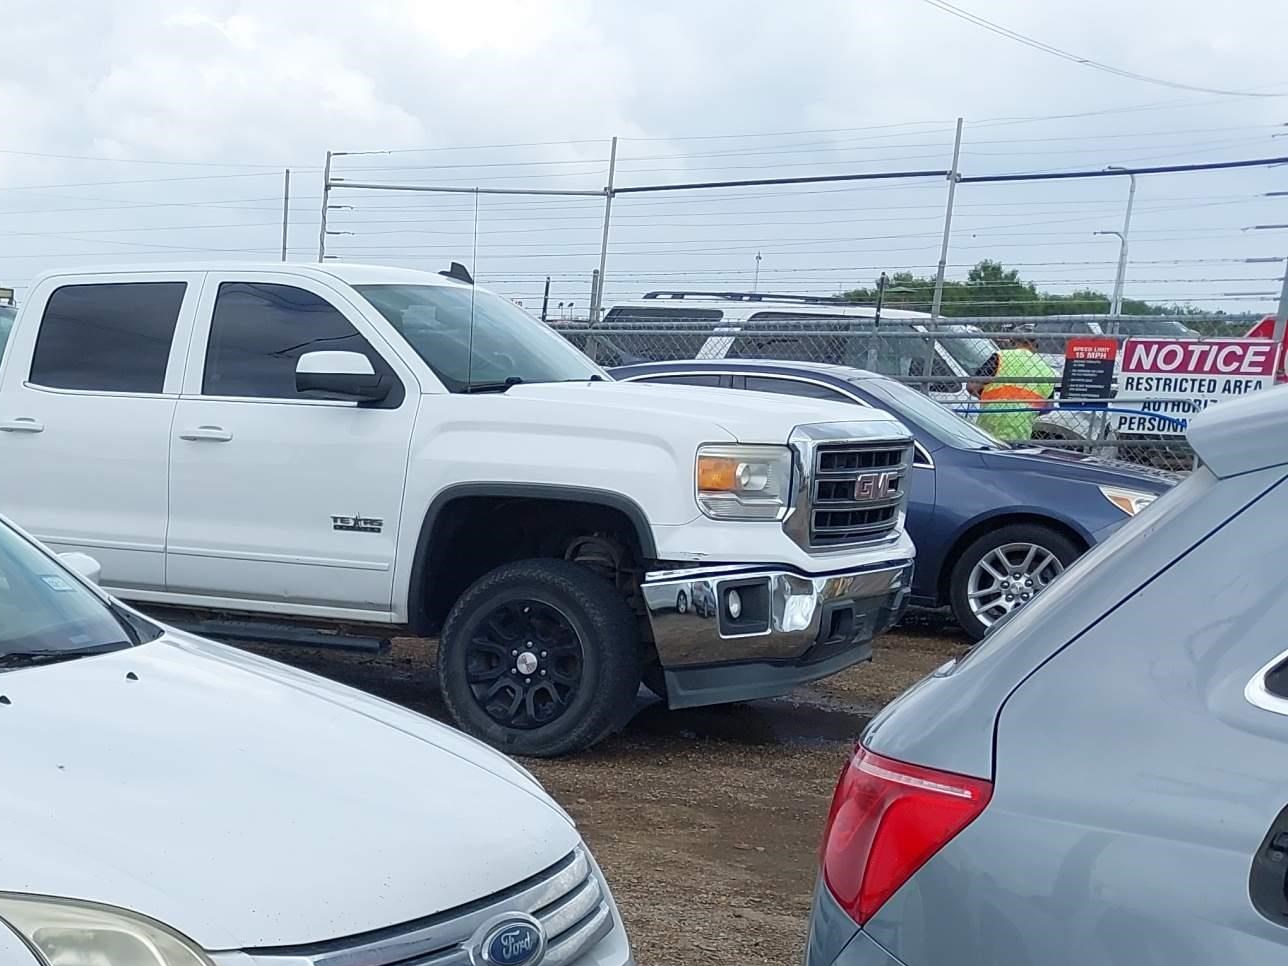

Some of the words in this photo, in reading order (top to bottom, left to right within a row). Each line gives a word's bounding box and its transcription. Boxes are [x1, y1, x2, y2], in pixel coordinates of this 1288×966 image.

[1087, 352, 1107, 360] MPH
[1129, 344, 1271, 373] NOTICE
[1125, 376, 1217, 393] RESTRICTED
[1142, 397, 1219, 414] AUTHORI
[855, 472, 898, 500] GMC
[501, 930, 532, 960] Ford
